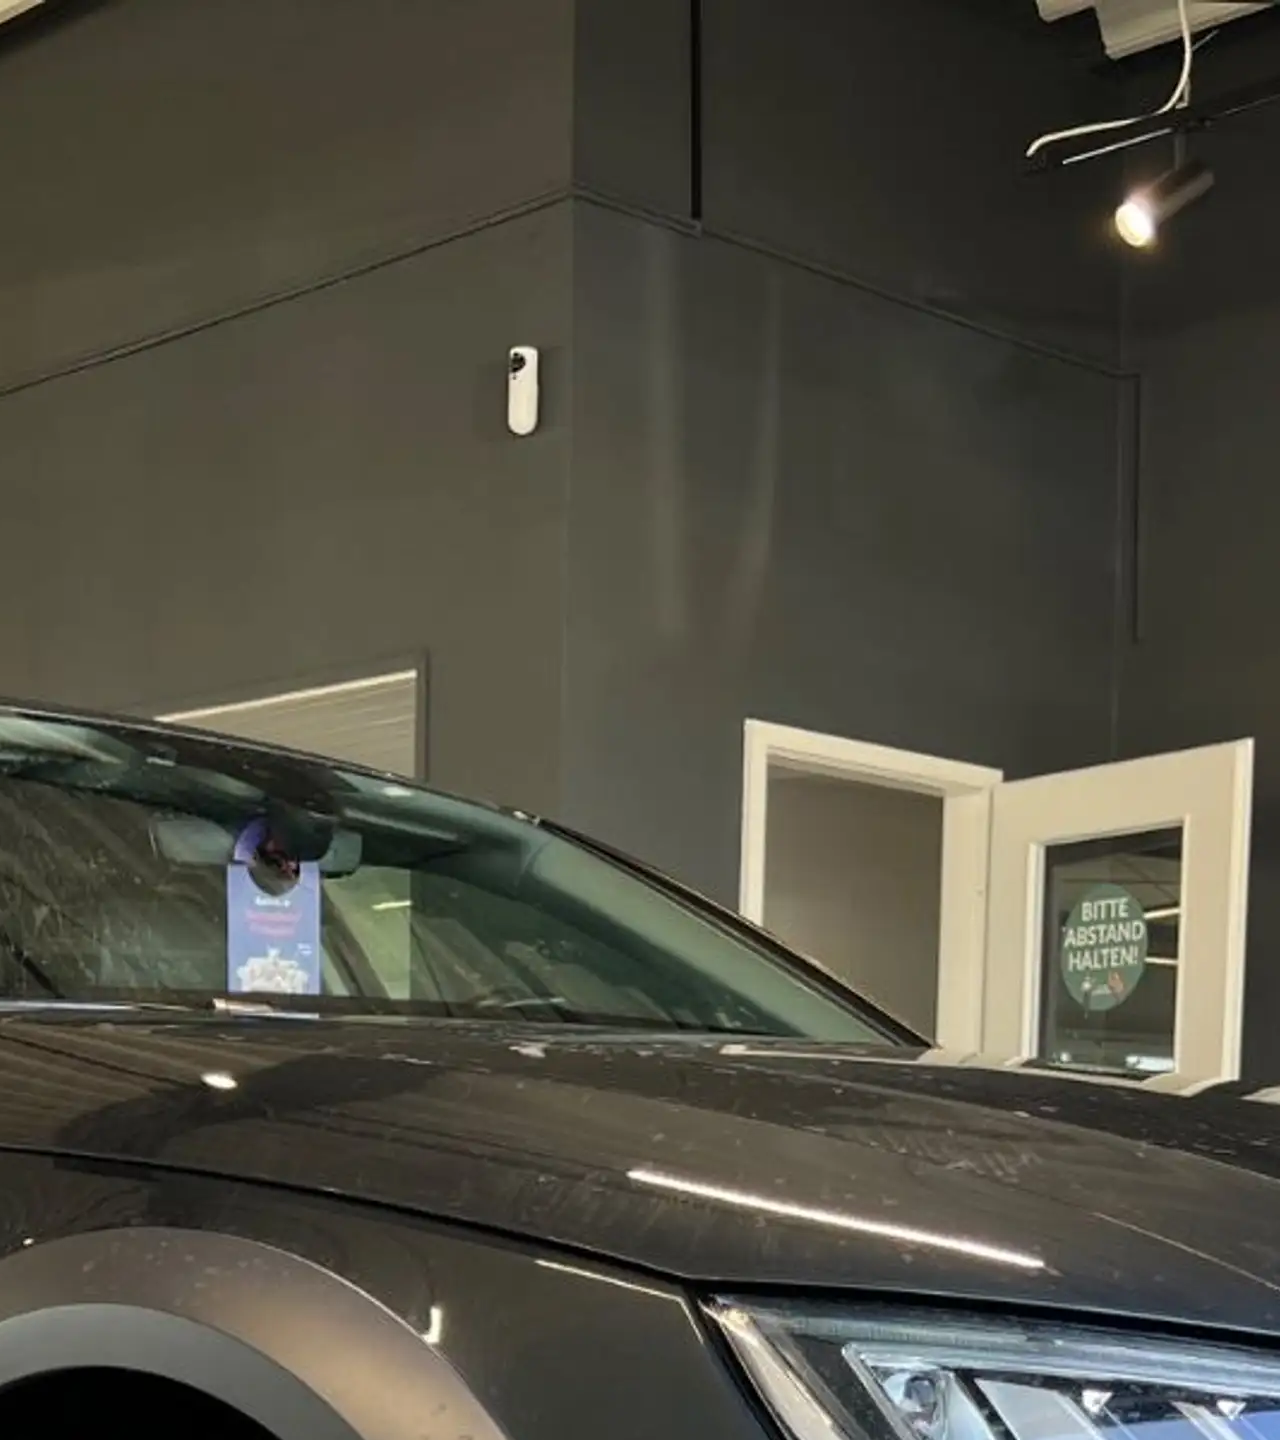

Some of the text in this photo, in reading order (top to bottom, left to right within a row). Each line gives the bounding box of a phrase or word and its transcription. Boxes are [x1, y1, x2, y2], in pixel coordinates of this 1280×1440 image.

[1081, 897, 1129, 922] BITTE
[1064, 920, 1145, 948] ABSTAND
[1068, 946, 1139, 972] HALTEN!
